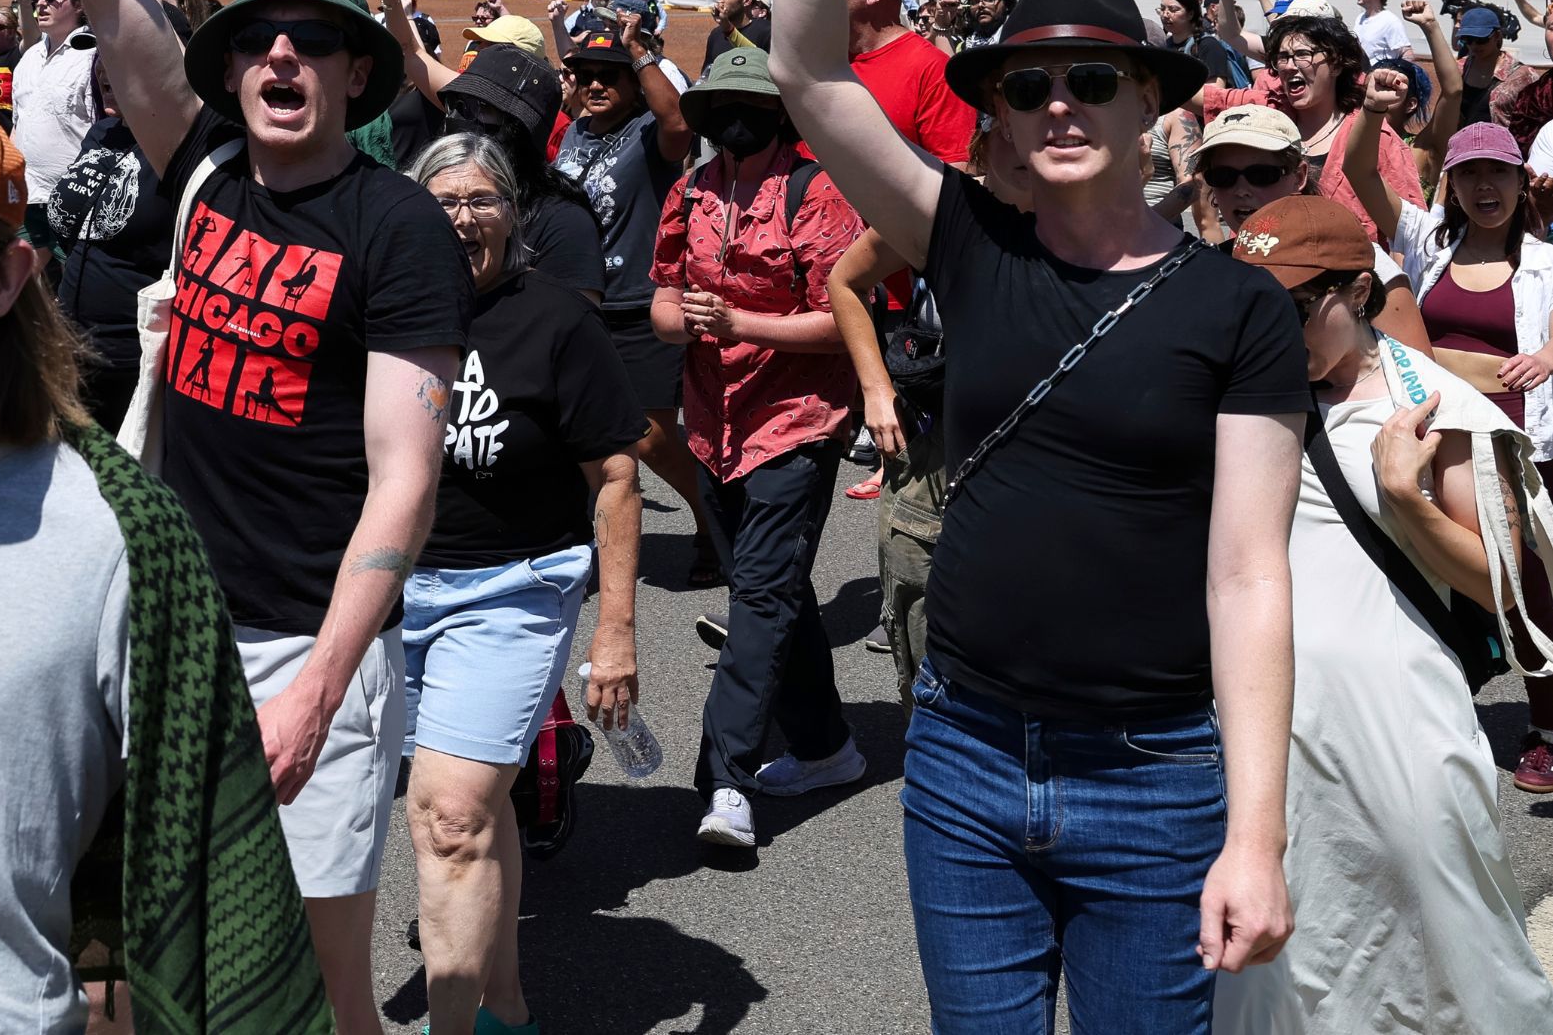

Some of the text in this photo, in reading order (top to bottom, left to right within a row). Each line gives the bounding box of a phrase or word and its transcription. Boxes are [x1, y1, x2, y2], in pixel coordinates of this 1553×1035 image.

[82, 166, 97, 177] WE
[173, 269, 321, 358] HICAGO
[463, 349, 485, 386] A
[1401, 370, 1427, 405] IND
[452, 380, 499, 425] TO
[443, 419, 510, 470] RATE
